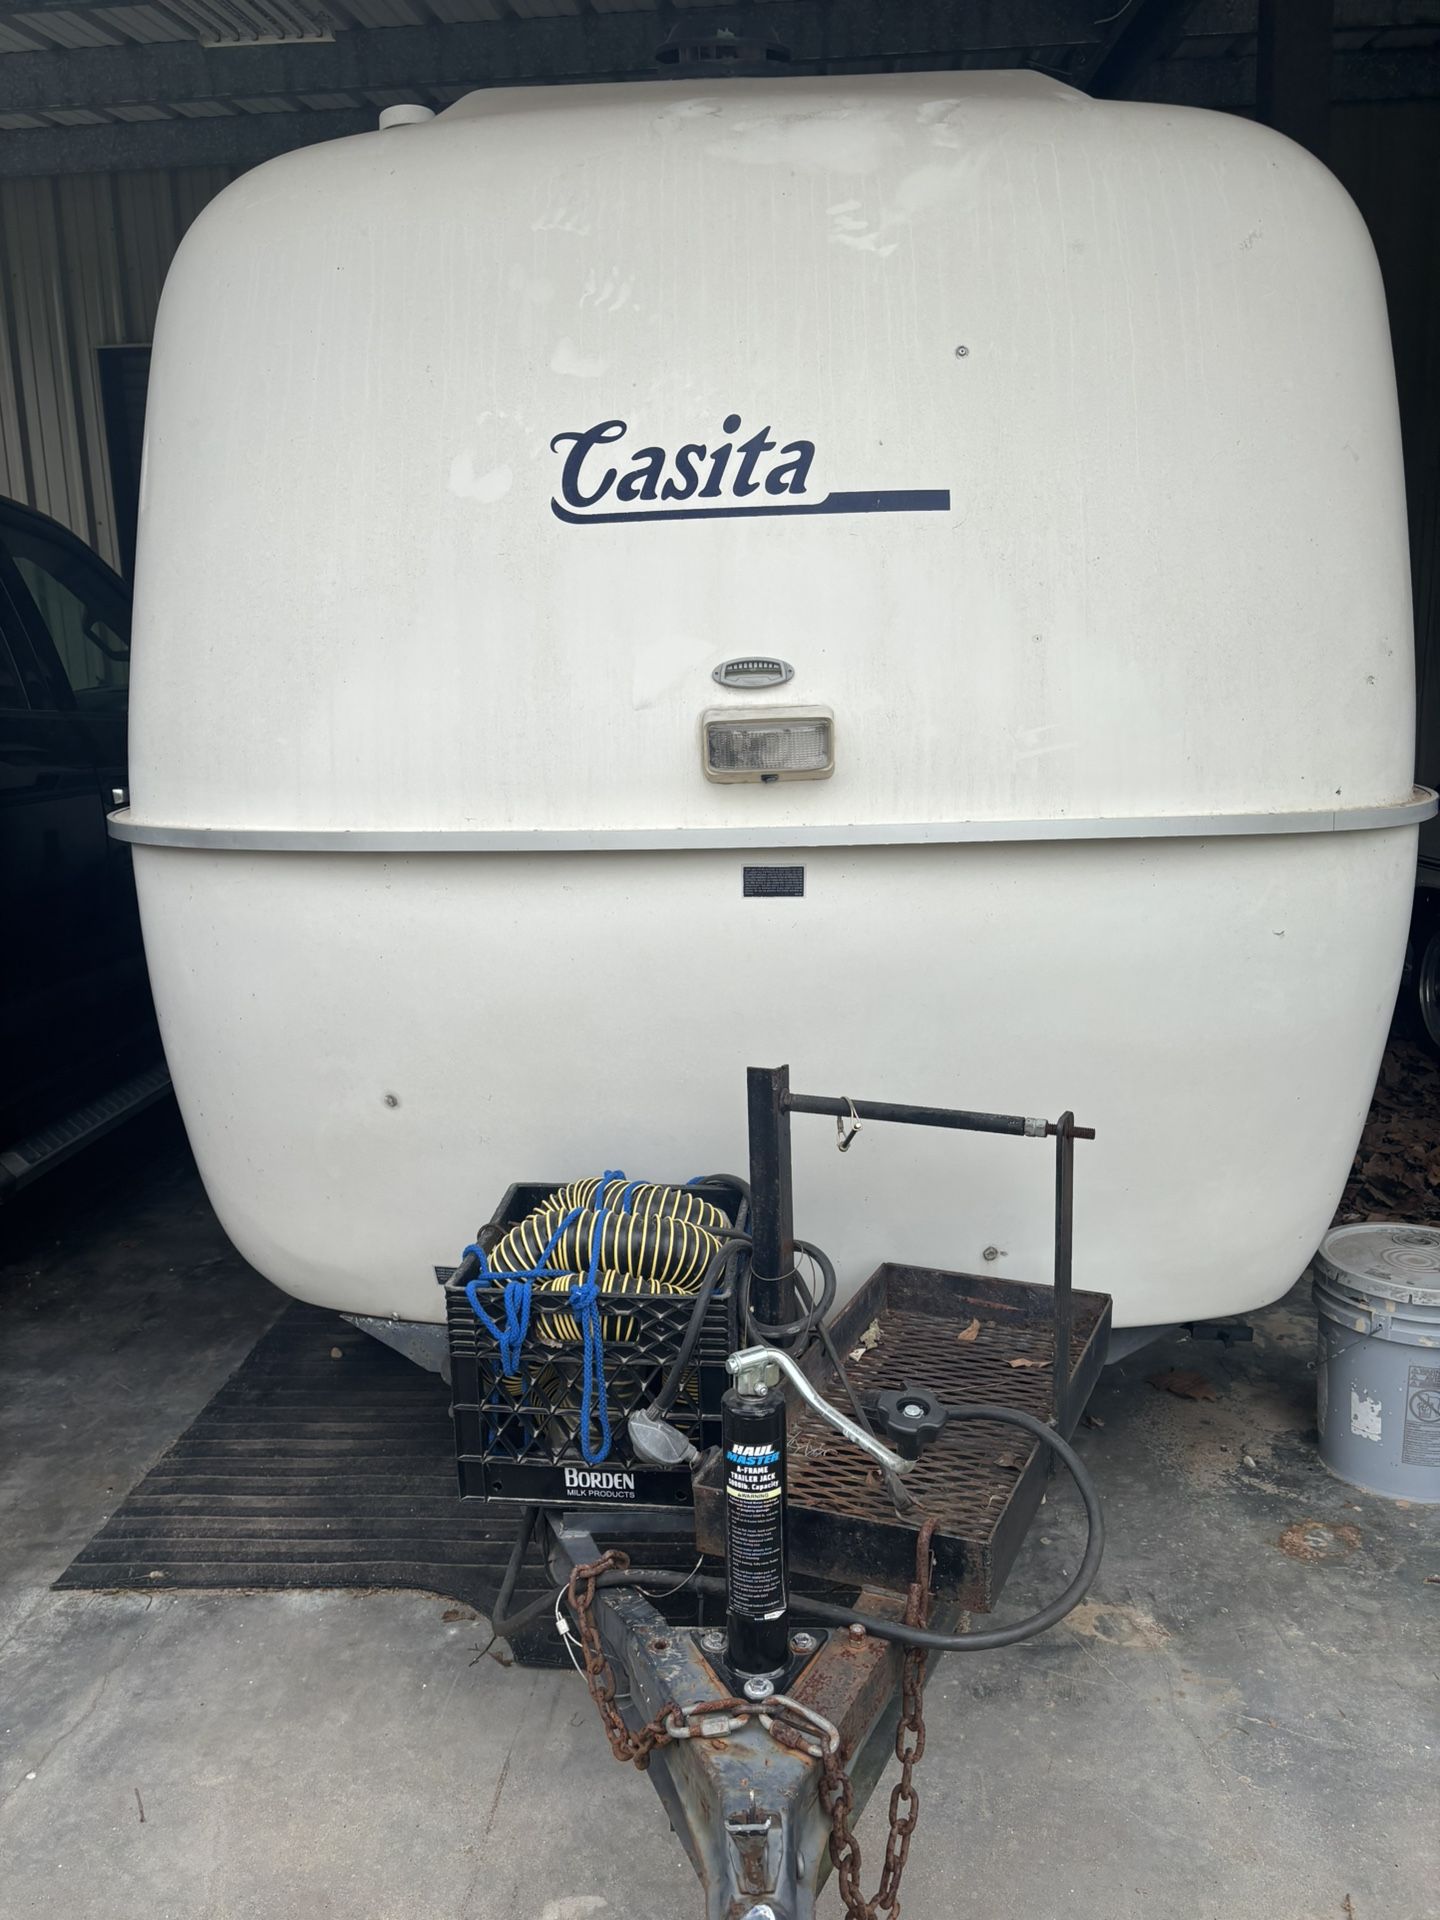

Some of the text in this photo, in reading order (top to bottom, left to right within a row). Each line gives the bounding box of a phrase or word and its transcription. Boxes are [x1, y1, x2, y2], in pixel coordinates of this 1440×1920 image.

[550, 413, 816, 508] Casita
[732, 1444, 775, 1456] HAUL
[727, 1451, 780, 1465] MASTER
[737, 1465, 768, 1474] A-FRAME
[564, 1467, 635, 1490] BORDEN
[731, 1471, 776, 1482] TRAILER JACK
[751, 1480, 779, 1491] Capacity
[588, 1490, 635, 1498] PRODUCTS
